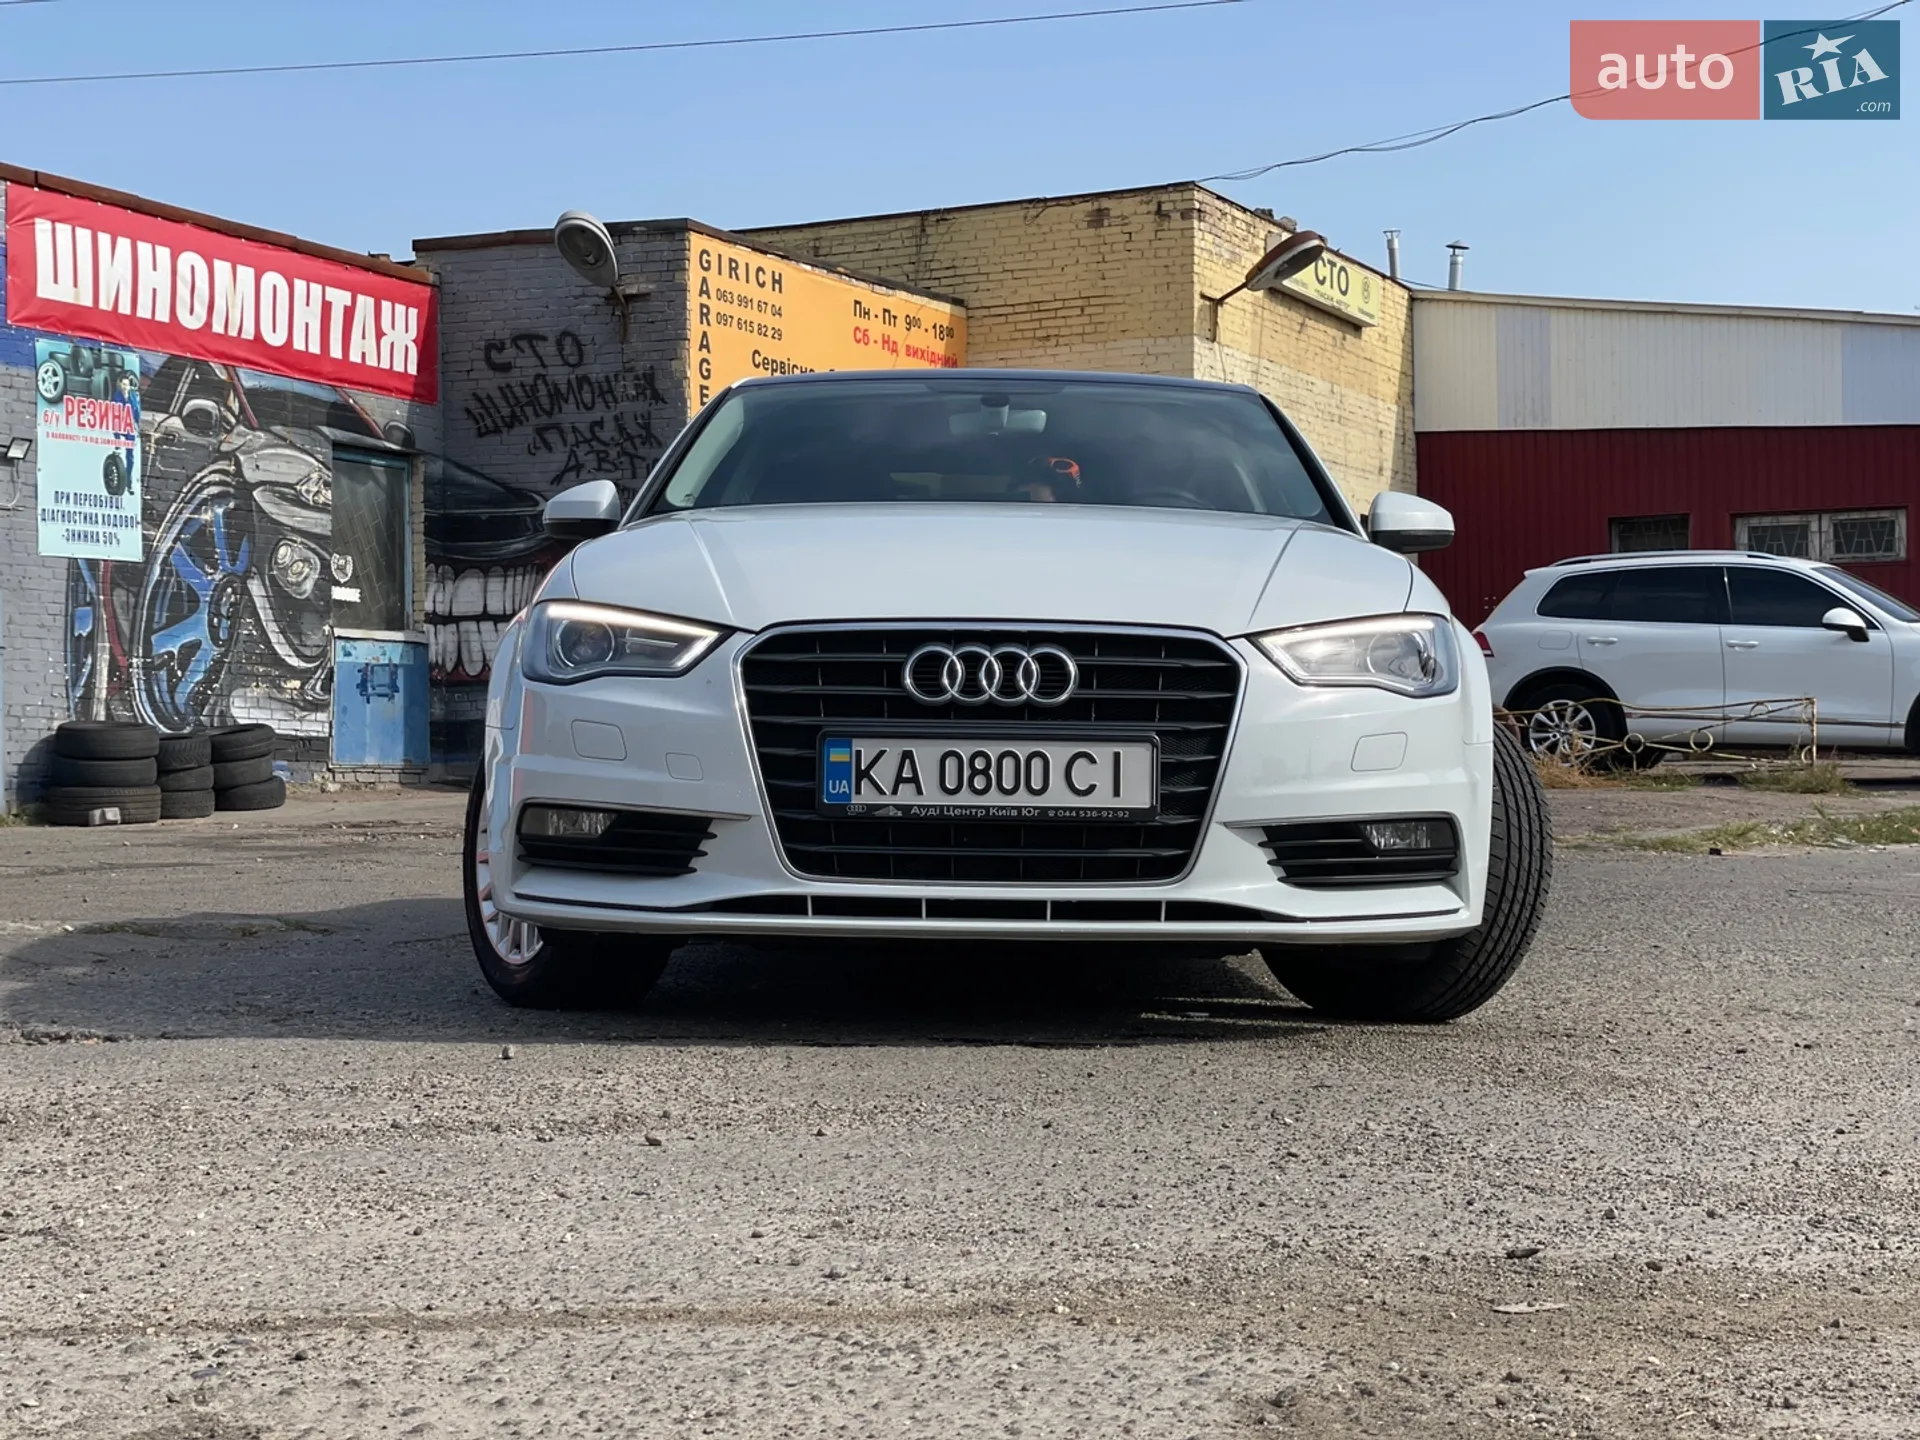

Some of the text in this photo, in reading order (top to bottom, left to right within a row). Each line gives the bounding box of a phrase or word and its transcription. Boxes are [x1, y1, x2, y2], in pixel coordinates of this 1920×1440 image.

[698, 249, 783, 294] GIRICH
[1315, 256, 1349, 296] СТО
[34, 217, 419, 376] ШИНОМОНТАЖ
[716, 288, 783, 318] 063 991 67 04
[854, 299, 870, 320] Пн
[882, 308, 897, 327] Пт
[716, 312, 783, 341] 097 615 82 29
[484, 331, 584, 372] СТО
[853, 326, 870, 346] Сб
[882, 333, 899, 357] Нд
[905, 346, 958, 368] вихідний
[63, 395, 135, 434] РЕЗИНА
[54, 490, 70, 505] ПРИ
[103, 531, 120, 546] 50%
[829, 780, 849, 794] UA
[854, 749, 925, 796] KA
[938, 749, 1051, 796] 0800
[910, 805, 940, 817] Ауді
[943, 806, 986, 818] Центр
[989, 807, 1018, 817] Київ
[1021, 807, 1040, 817] Юг
[1057, 810, 1076, 818] 044
